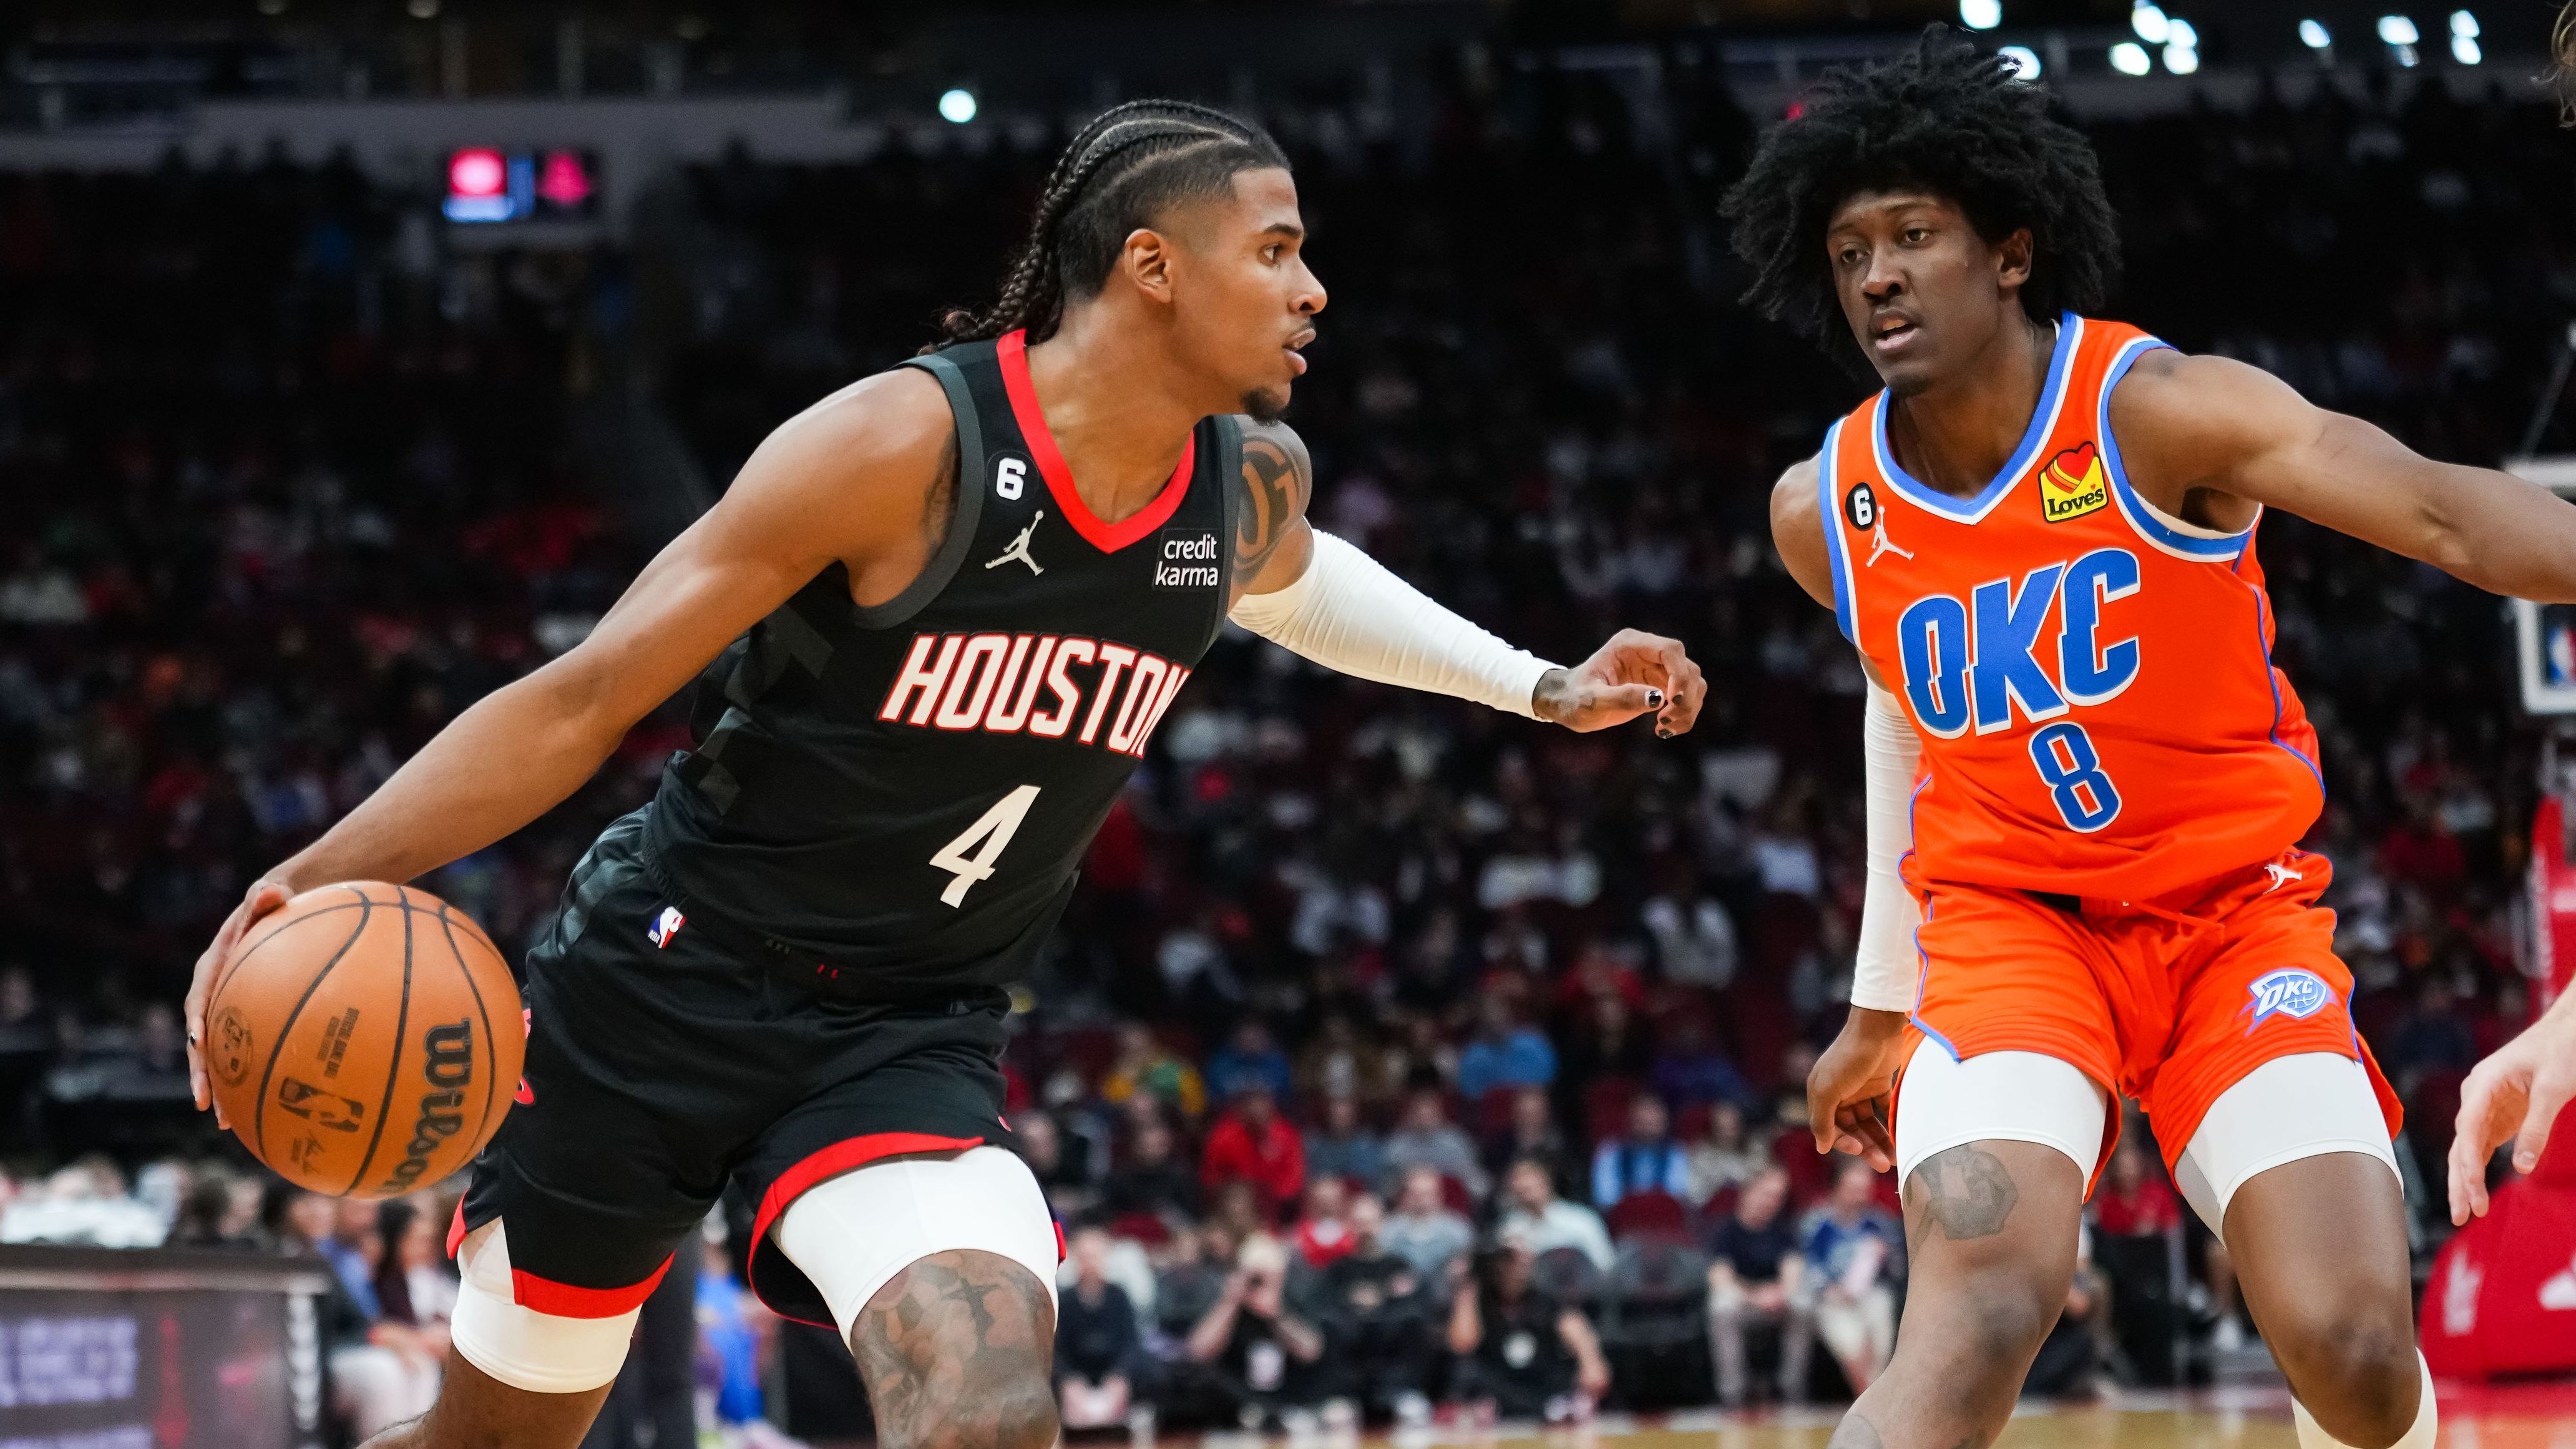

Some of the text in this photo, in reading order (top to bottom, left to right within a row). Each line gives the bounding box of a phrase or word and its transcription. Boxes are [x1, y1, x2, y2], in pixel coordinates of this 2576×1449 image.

[996, 457, 1027, 500] 6
[1855, 490, 1873, 525] 6
[2047, 488, 2104, 516] Loves
[1164, 534, 1217, 559] credit
[1155, 560, 1218, 586] karma
[1897, 547, 2140, 739] OKC
[877, 632, 1193, 759] HOUSTON
[2028, 721, 2122, 833] 8
[929, 784, 1041, 909] 4
[648, 930, 660, 944] NBA
[2256, 980, 2313, 1017] OKC
